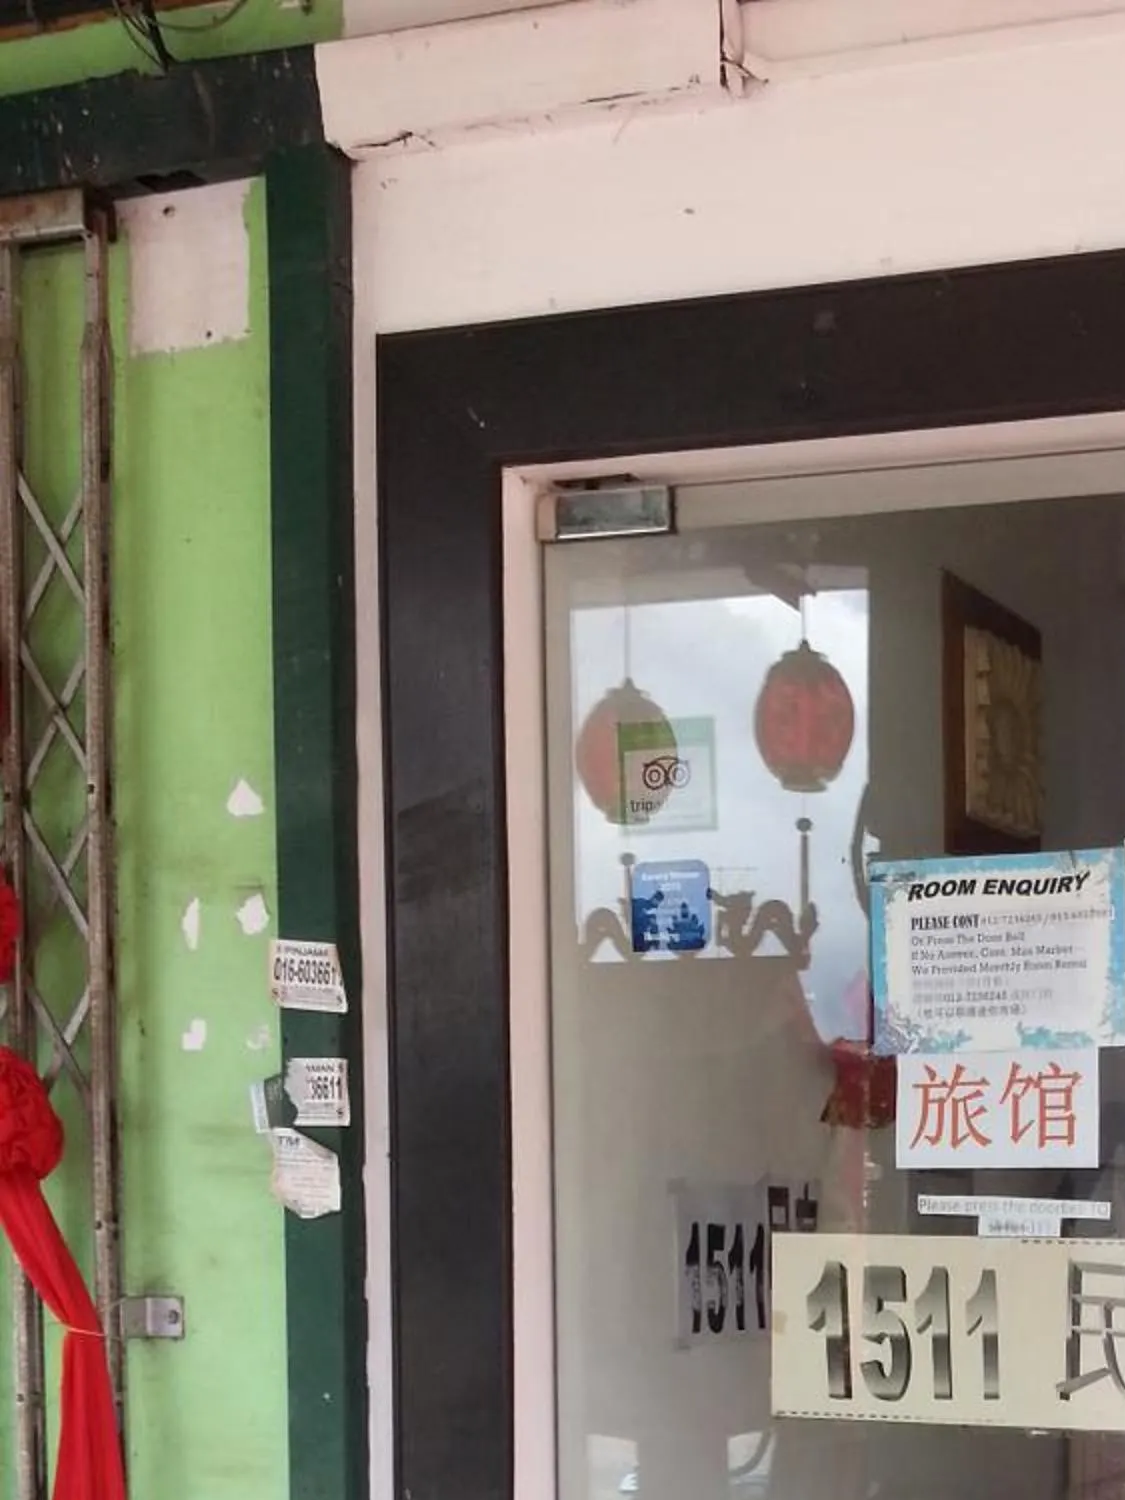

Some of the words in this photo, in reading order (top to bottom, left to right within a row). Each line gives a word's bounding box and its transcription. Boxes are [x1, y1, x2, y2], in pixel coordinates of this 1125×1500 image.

[908, 879, 977, 902] ROOM
[982, 871, 1090, 896] ENQUIRY
[911, 915, 951, 930] PLEASE
[908, 1060, 1083, 1150] 旅馆
[919, 1196, 962, 1212] Please
[685, 1222, 766, 1334] 1511
[806, 1259, 1001, 1402] 1511
